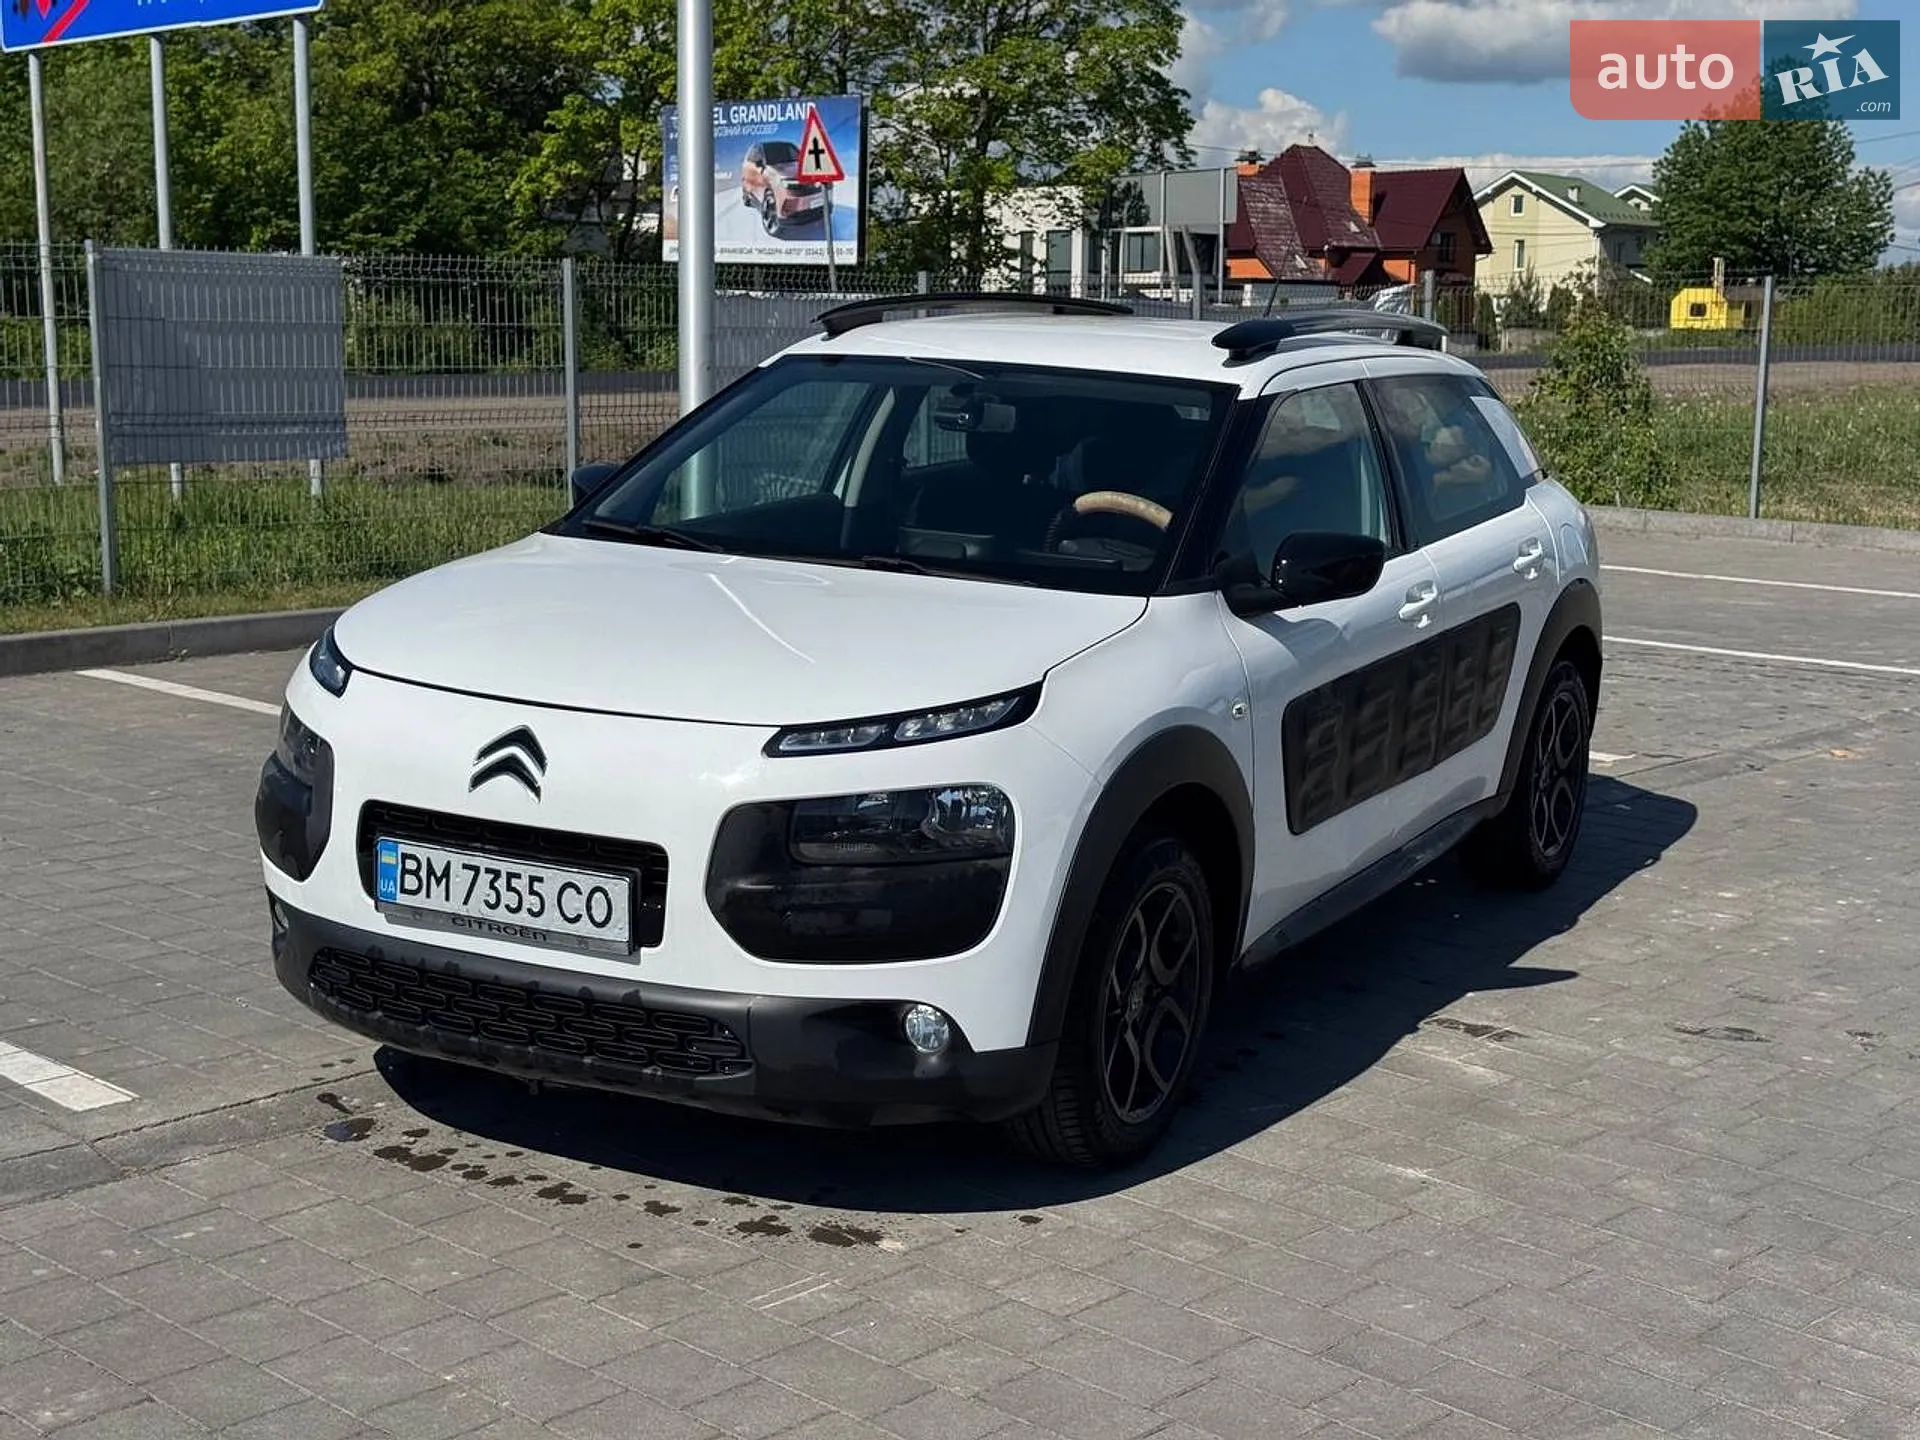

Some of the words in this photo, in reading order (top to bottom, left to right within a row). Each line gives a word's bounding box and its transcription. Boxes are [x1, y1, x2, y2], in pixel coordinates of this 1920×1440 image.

[713, 106, 726, 125] EL
[380, 877, 397, 895] UA
[400, 852, 450, 902] BM
[461, 863, 545, 918] 7355
[556, 881, 613, 929] CO
